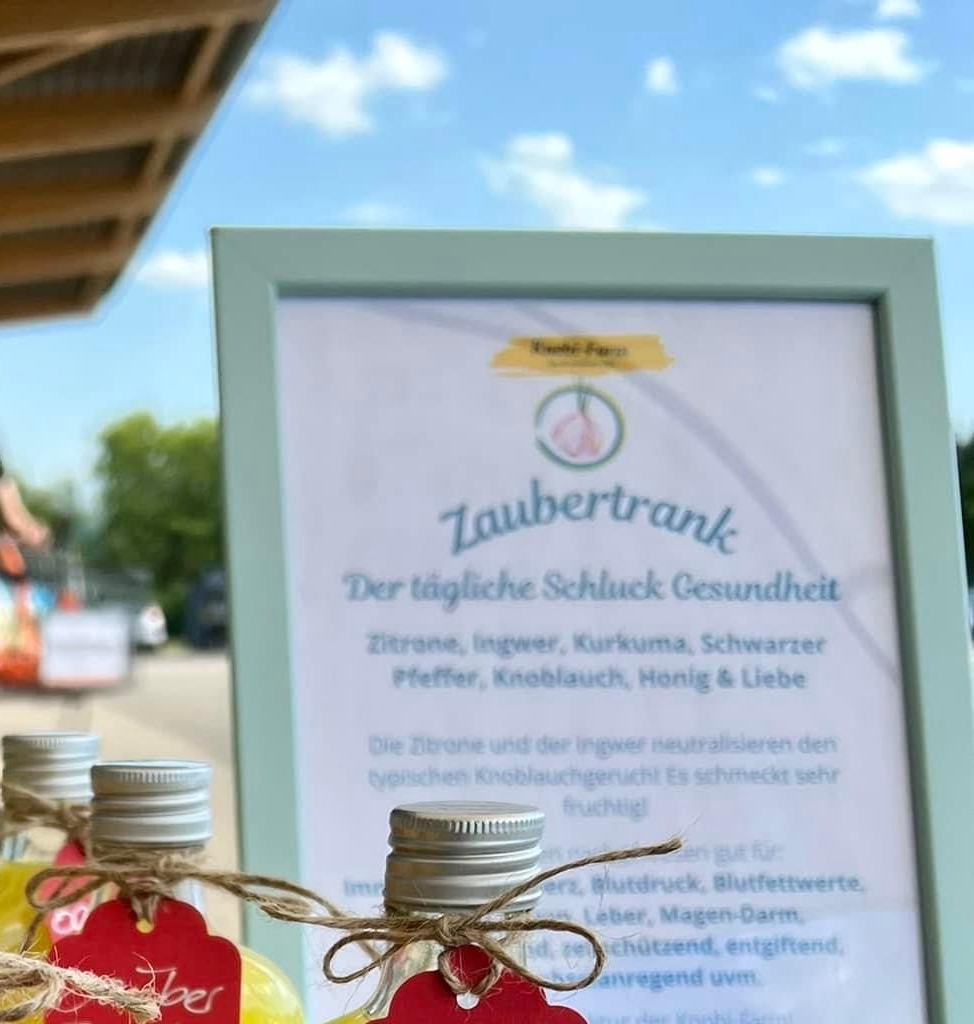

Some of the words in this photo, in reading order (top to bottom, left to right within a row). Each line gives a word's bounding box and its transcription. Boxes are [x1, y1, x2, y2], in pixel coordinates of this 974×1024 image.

[438, 477, 738, 555] Zaubertrank
[342, 569, 404, 601] Der
[410, 569, 533, 613] tägliche
[543, 569, 664, 601] Schluck
[672, 570, 841, 602] Gesundheit
[367, 632, 467, 656] Zitrone,
[473, 632, 567, 659] Ingwer,
[574, 631, 695, 655] Kurkuma,
[701, 633, 827, 655] Schwarzer
[392, 666, 486, 691] Pfeffer,
[493, 666, 632, 691] Knoblauch,
[639, 668, 710, 694] Honig
[717, 668, 733, 688] &
[741, 667, 807, 689] Liebe
[369, 735, 402, 756] Die
[409, 735, 484, 756] Zitrone
[490, 734, 533, 755] und
[537, 734, 572, 755] der
[576, 735, 643, 759] Ingwer
[651, 734, 792, 754] neutralisieren
[797, 734, 837, 754] den
[369, 766, 468, 791] typischen
[666, 766, 689, 785] Es
[695, 765, 789, 785] schmeckt
[794, 765, 840, 784] sehr
[543, 878, 586, 896] erz,
[713, 873, 867, 895] Blutfettwerte,
